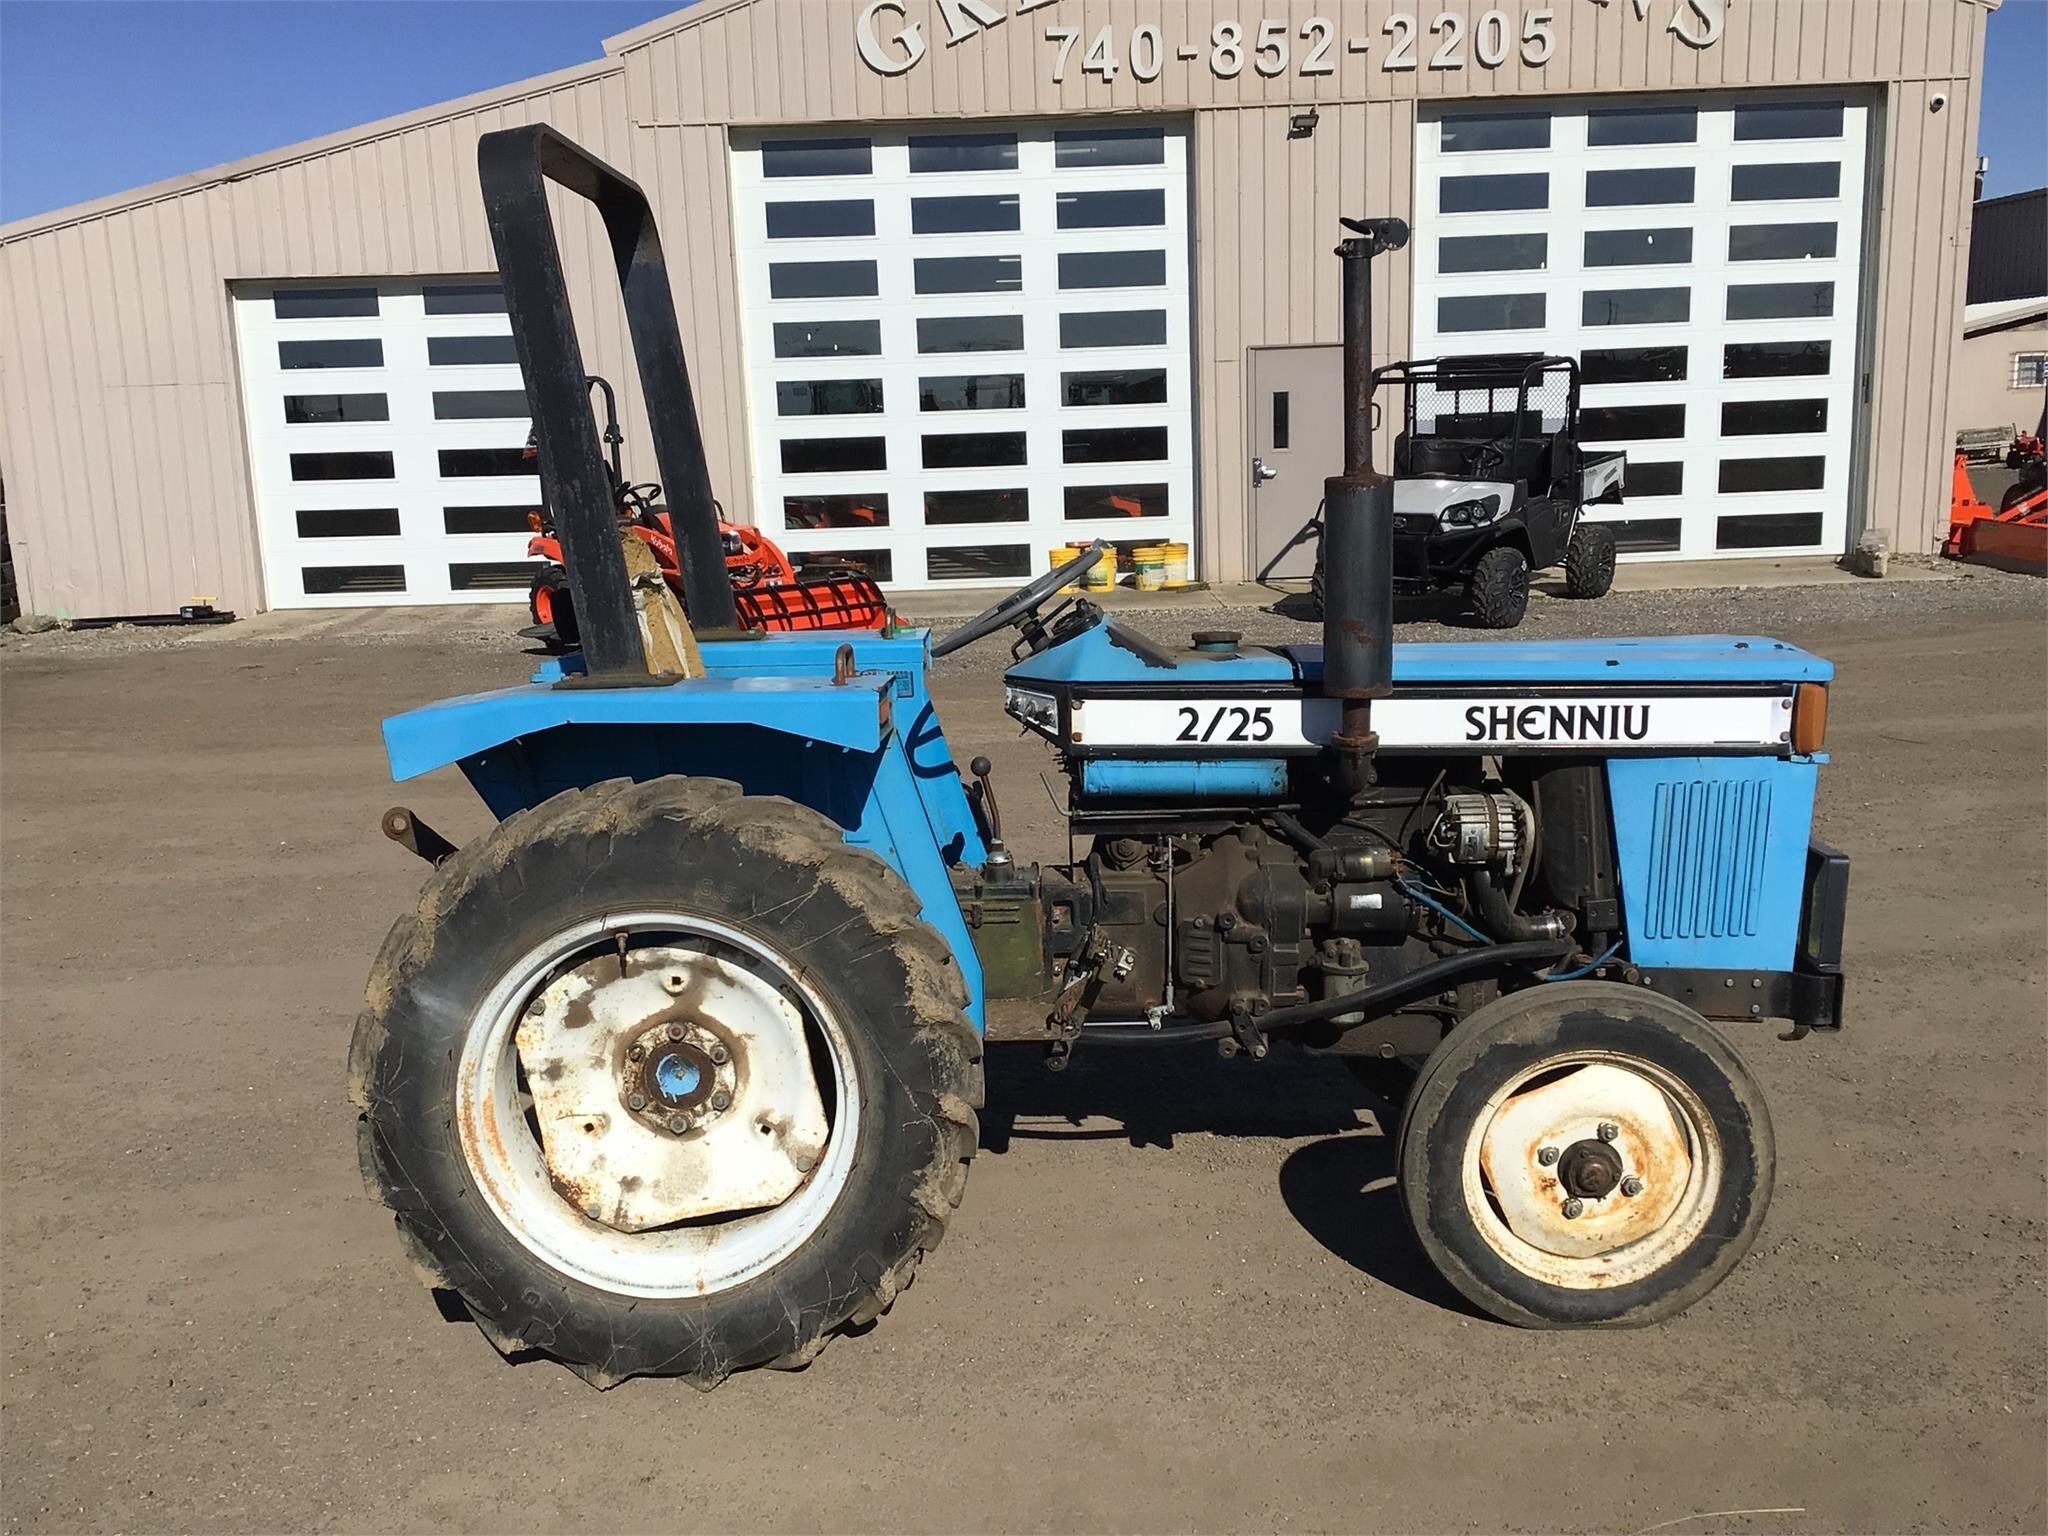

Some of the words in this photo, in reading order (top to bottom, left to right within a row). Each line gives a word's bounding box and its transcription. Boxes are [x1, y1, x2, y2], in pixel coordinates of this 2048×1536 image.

[1045, 8, 1555, 84] 740-852-2205
[1176, 707, 1274, 742] 2/25
[1465, 705, 1651, 741] SHENNIU
